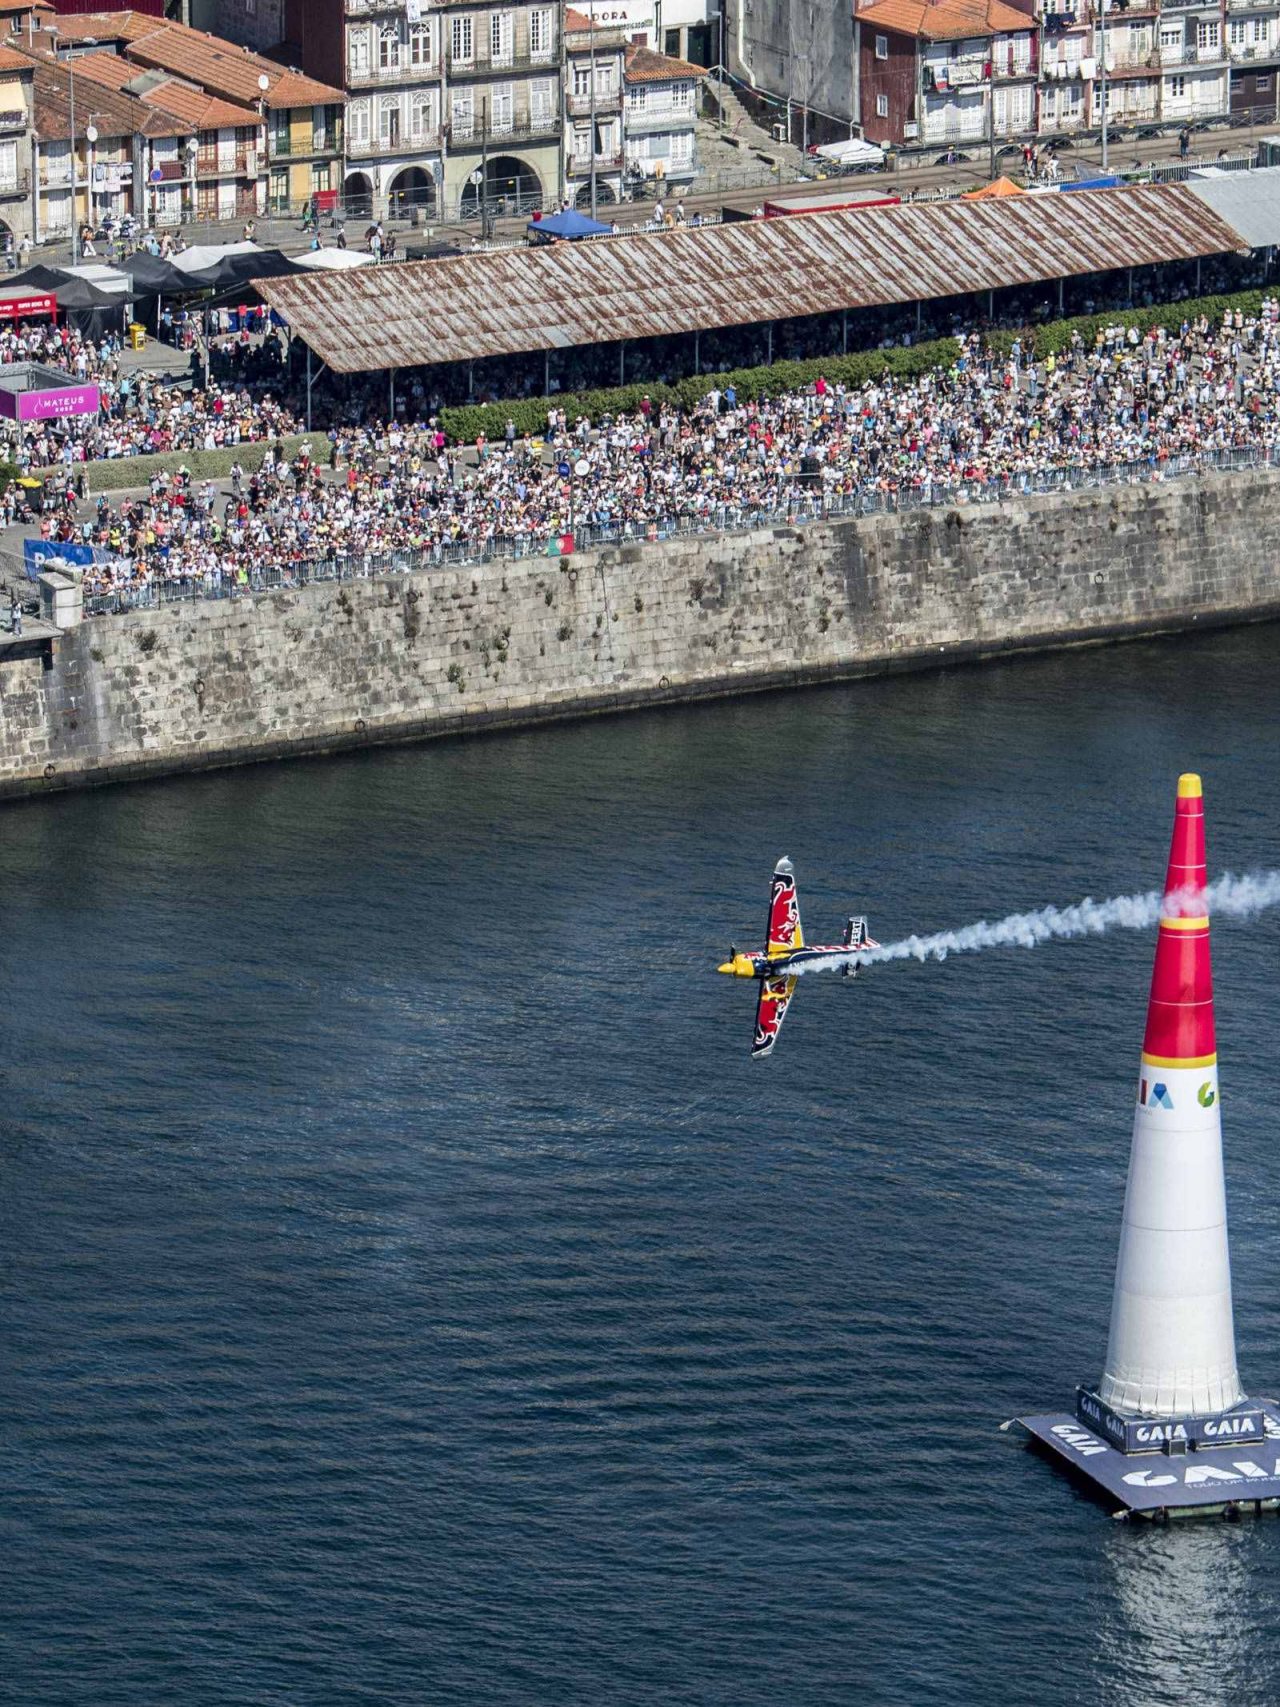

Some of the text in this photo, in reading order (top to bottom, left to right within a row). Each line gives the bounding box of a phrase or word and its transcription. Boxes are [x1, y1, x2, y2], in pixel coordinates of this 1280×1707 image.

[43, 396, 84, 408] MATEUS
[1081, 1397, 1100, 1422] GAIA
[1106, 1414, 1125, 1440] GAIA
[1136, 1424, 1189, 1442] GAIA
[1203, 1417, 1256, 1436] GAIA
[1050, 1424, 1108, 1457] GAIA
